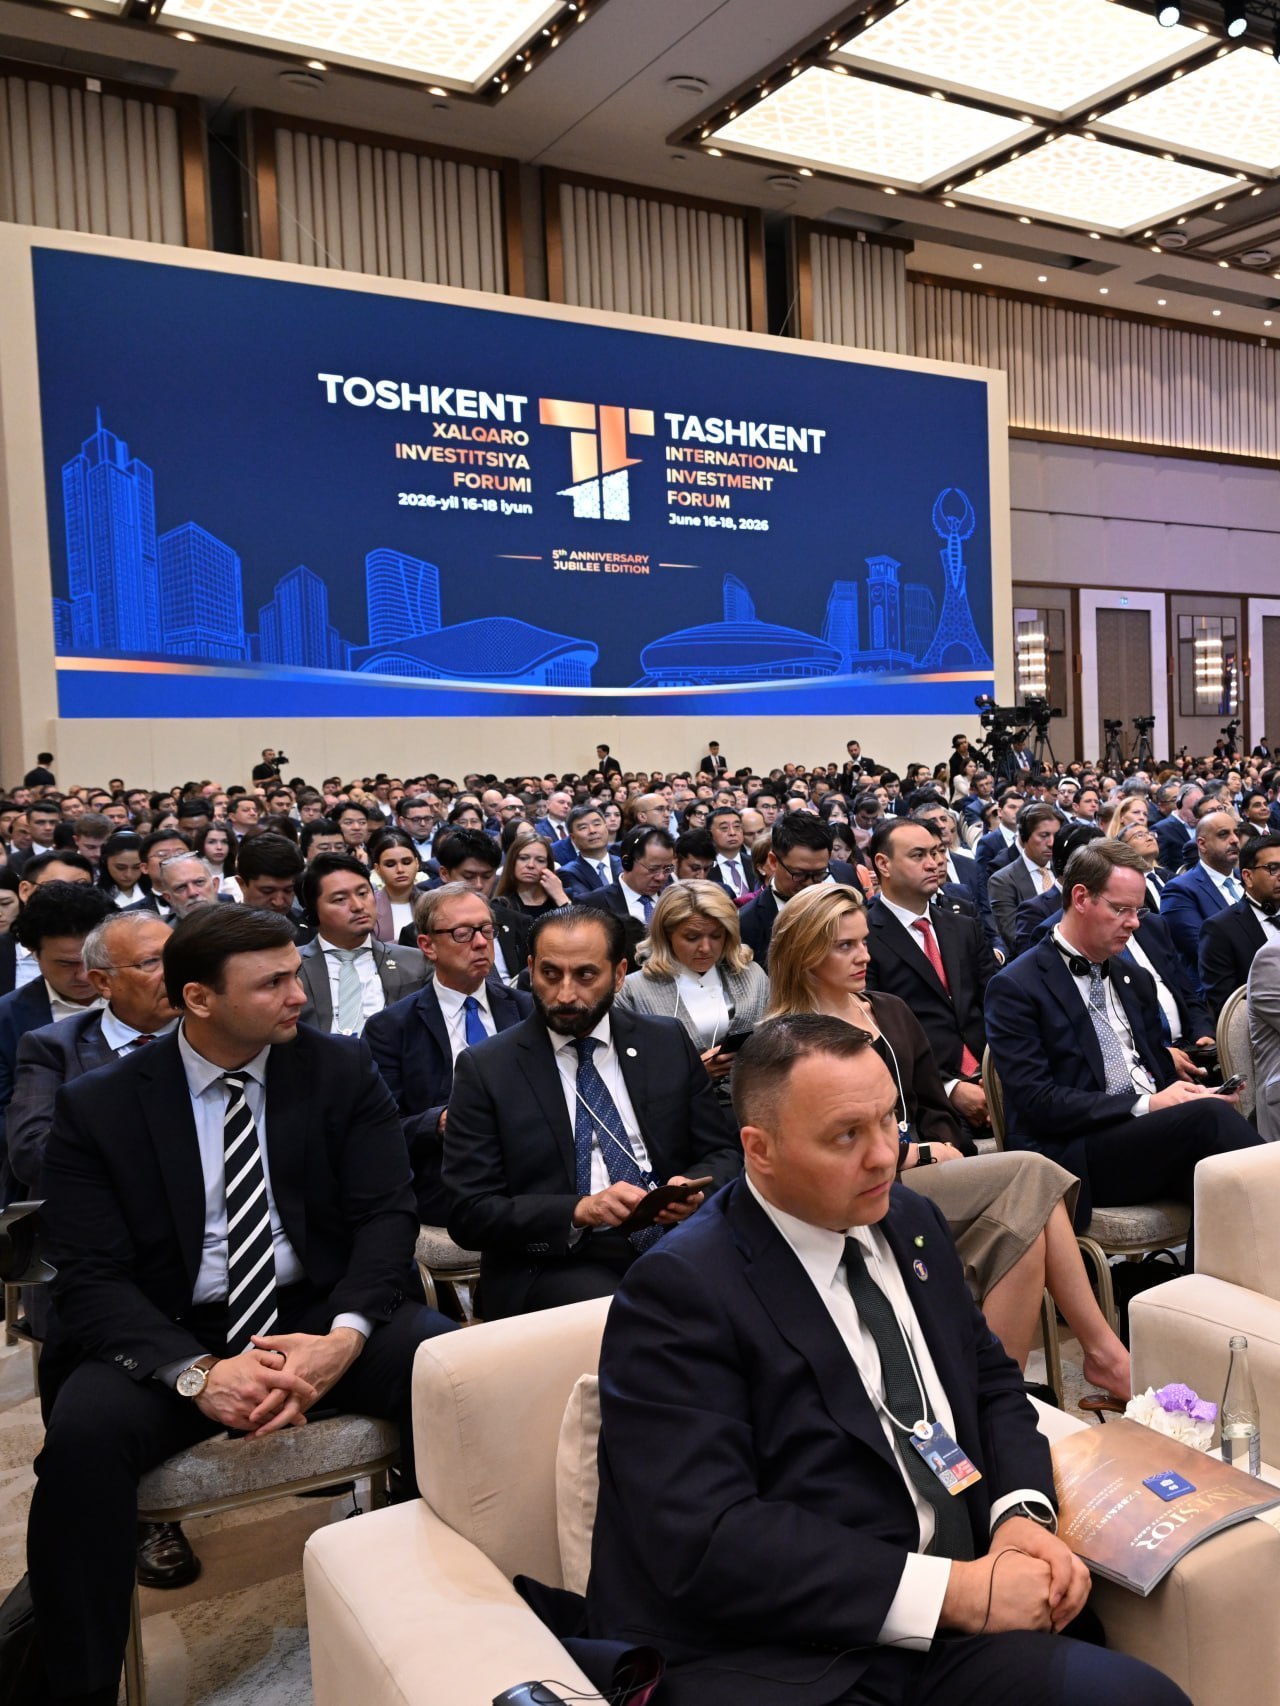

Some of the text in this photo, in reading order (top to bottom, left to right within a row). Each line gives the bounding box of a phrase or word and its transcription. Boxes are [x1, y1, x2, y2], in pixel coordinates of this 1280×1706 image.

[317, 372, 528, 423] TOSHKENT
[432, 421, 530, 446] XALQARO
[663, 412, 826, 454] TASHKENT
[395, 442, 530, 470] INVESTITSIYA
[665, 445, 798, 473] INTERNATIONAL
[453, 471, 532, 493] FORUMI
[666, 468, 774, 491] INVESTMENT
[398, 492, 533, 516] 2026-yil 16-18 iyun
[667, 490, 731, 509] FORUM
[668, 512, 770, 531] June 16-18, 2026
[552, 548, 650, 564] 5th ANNIVERSARY
[553, 560, 650, 575] JUBILEE EDITION
